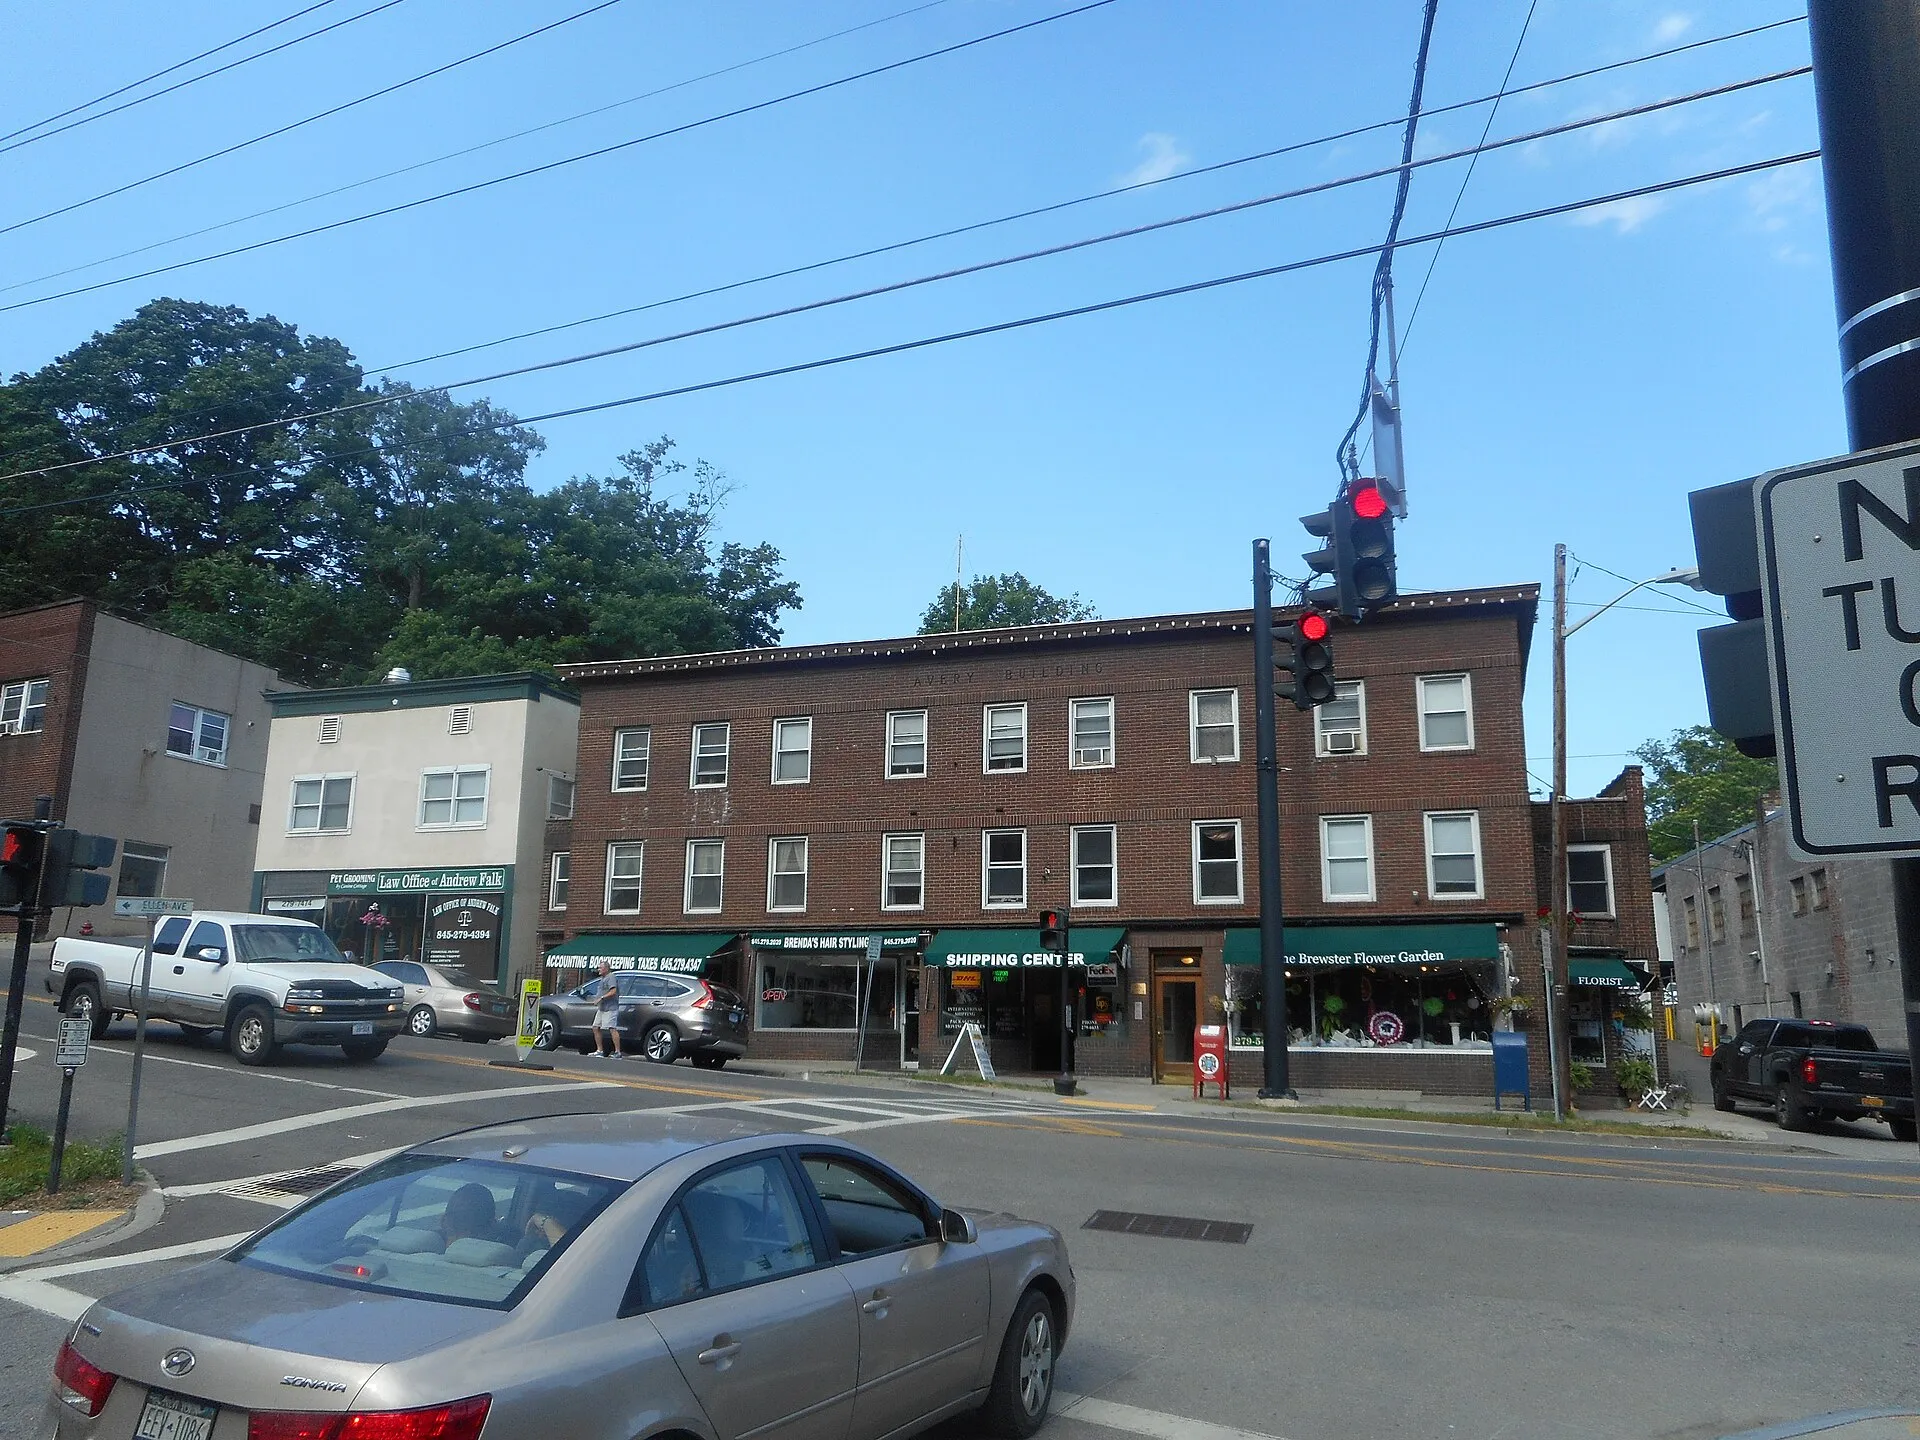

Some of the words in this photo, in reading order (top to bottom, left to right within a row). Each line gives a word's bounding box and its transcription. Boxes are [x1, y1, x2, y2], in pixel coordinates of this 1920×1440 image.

[1838, 465, 1920, 562] N
[1822, 576, 1920, 651] TU
[914, 672, 975, 687] AVERY
[1005, 663, 1104, 680] BUILDING
[330, 874, 342, 883] PET
[343, 873, 376, 883] GROOMING
[379, 875, 400, 888] Law
[401, 874, 430, 888] Office
[439, 873, 477, 887] Andrew
[478, 872, 502, 887] Falk
[142, 901, 168, 909] ELLEN
[171, 902, 187, 910] AVE
[432, 905, 442, 917] LAW
[442, 899, 460, 911] OFFICE
[460, 898, 467, 907] OF
[467, 898, 487, 909] ANDREW
[486, 903, 500, 916] FALK
[436, 930, 491, 939] 845-279-4394
[783, 937, 819, 949] BRENDA'S
[820, 937, 837, 949] HAIR
[838, 936, 870, 948] STYLING
[546, 954, 588, 969] ACCOUNTING
[637, 956, 659, 971] TAXES
[946, 953, 1018, 966] SHIPPING
[1022, 953, 1085, 966] CENTER
[1298, 952, 1352, 965] Brewster
[1353, 952, 1396, 964] Flower
[1398, 949, 1445, 962] Garden
[1089, 966, 1115, 975] FedEx
[1577, 976, 1623, 986] FLORIST
[761, 990, 786, 1001] OPEN
[1234, 1036, 1264, 1045] 279-5
[280, 1375, 347, 1393] SONATA
